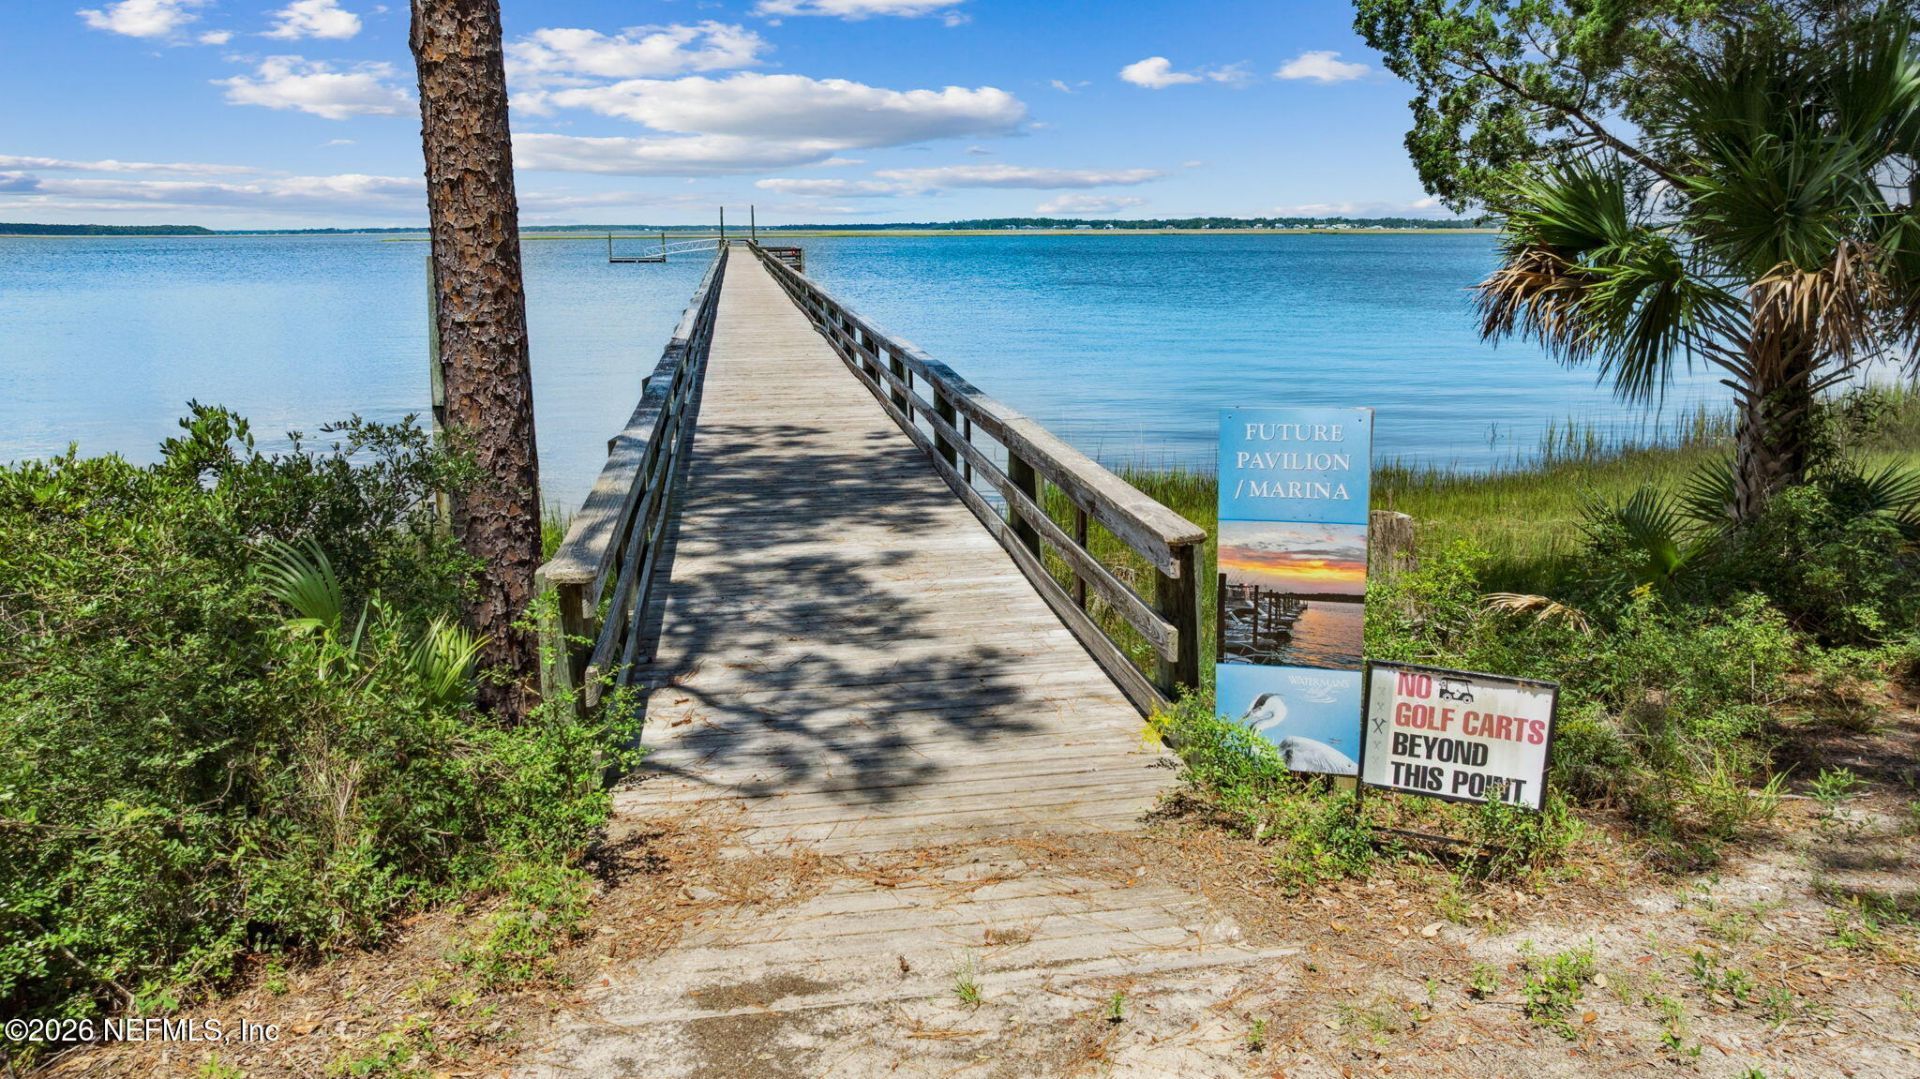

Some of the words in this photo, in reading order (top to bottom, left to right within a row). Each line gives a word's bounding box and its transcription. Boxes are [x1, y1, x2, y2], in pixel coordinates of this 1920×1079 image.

[1245, 423, 1345, 441] FUTURE
[1236, 451, 1351, 471] PAVILION
[1249, 481, 1350, 500] MARINA
[1397, 672, 1432, 699] NO
[1395, 702, 1455, 732] GOLF
[1462, 710, 1546, 745] CARTS
[1392, 731, 1489, 767] BEYOND
[1391, 761, 1444, 791] THIS
